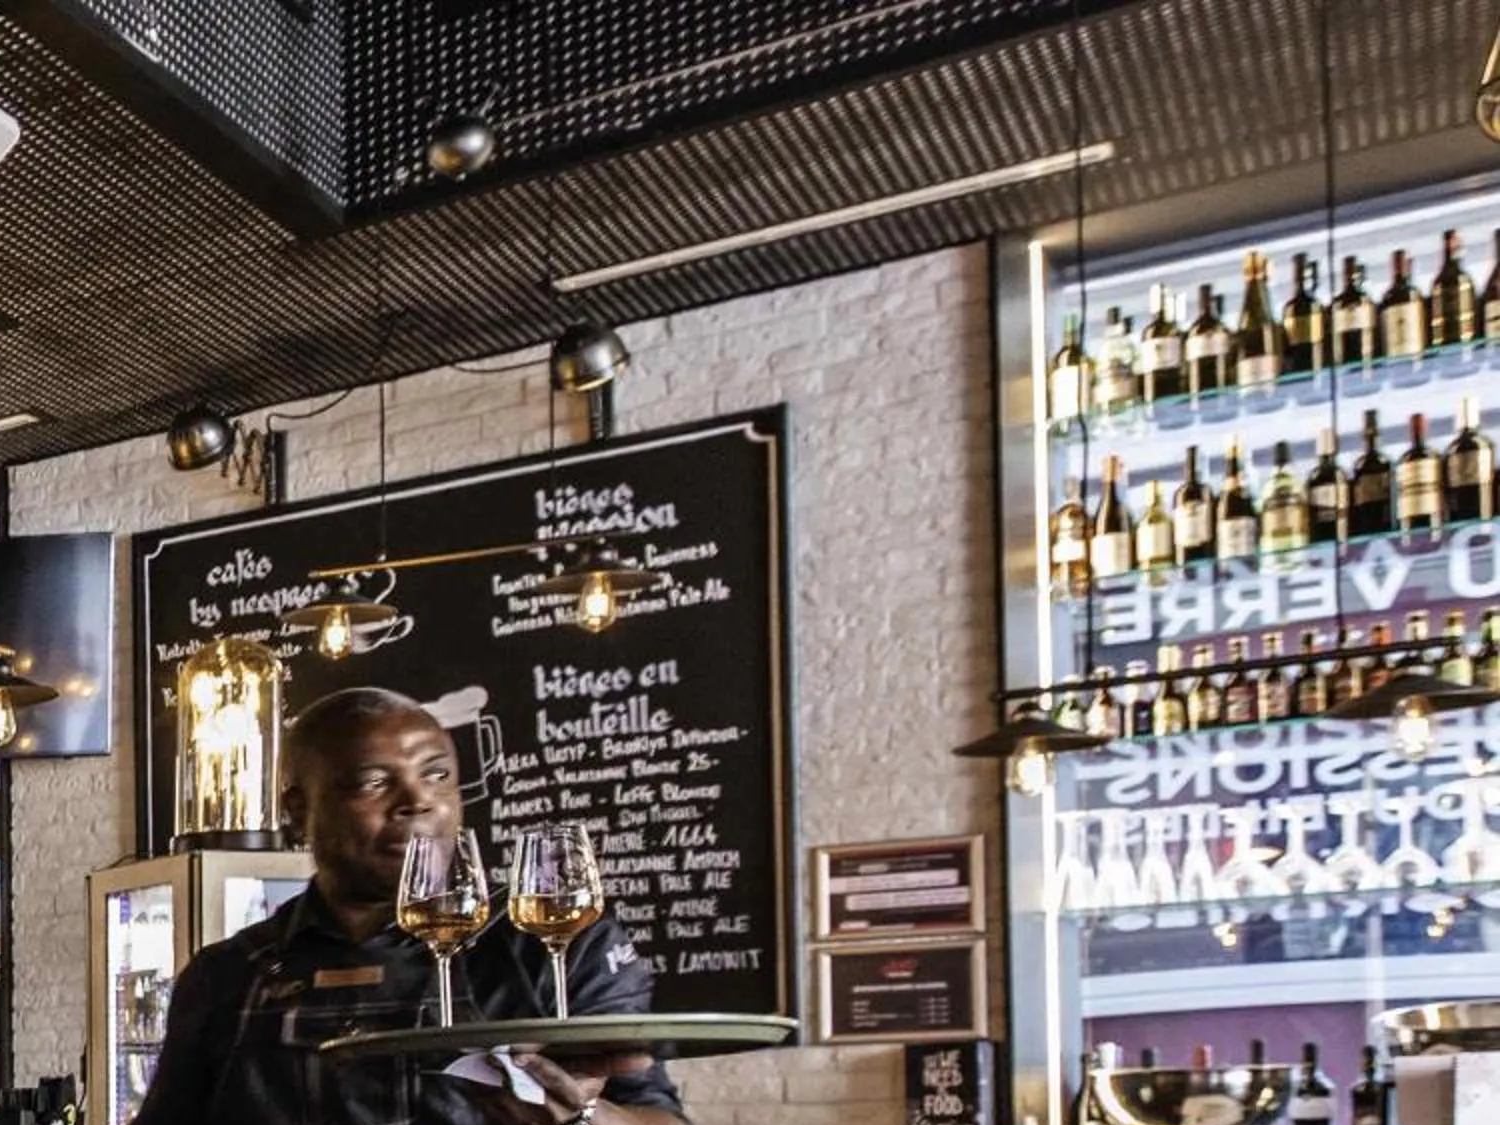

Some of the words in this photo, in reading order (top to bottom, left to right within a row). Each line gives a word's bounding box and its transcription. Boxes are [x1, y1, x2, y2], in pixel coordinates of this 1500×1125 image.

[639, 660, 680, 688] en
[536, 694, 673, 742] bouteille
[661, 824, 719, 847] 1664
